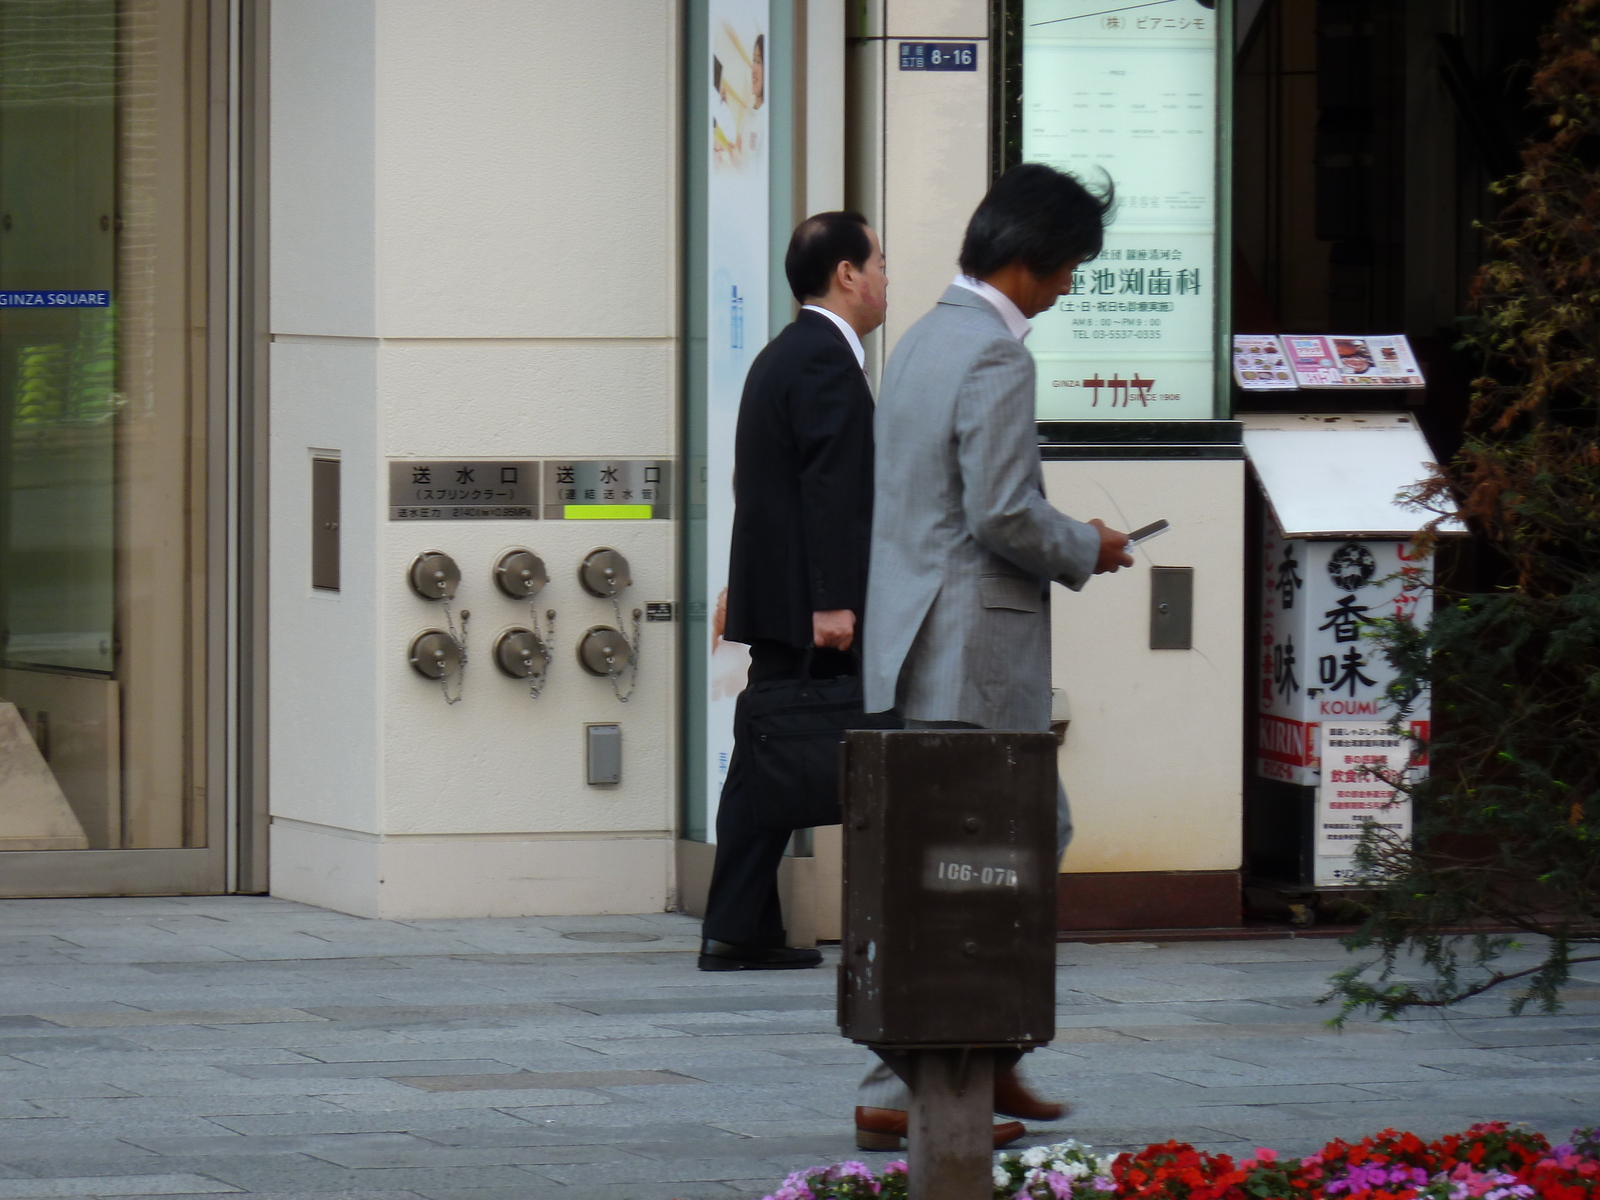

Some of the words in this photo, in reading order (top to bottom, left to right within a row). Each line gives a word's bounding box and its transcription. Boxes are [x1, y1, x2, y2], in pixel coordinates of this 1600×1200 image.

[931, 49, 972, 65] 8-16
[0, 294, 44, 305] GINZA
[47, 293, 106, 305] SQUARE
[1072, 330, 1090, 339] TEL
[1052, 380, 1081, 388] GINZA
[1083, 373, 1156, 408] ナカヤ
[1129, 393, 1157, 402] SINCE
[412, 466, 518, 485] 送水口
[556, 466, 661, 484] 送水口
[1318, 594, 1378, 698] 香味
[1319, 700, 1379, 715] KOUMI
[1259, 717, 1304, 757] KIRIN
